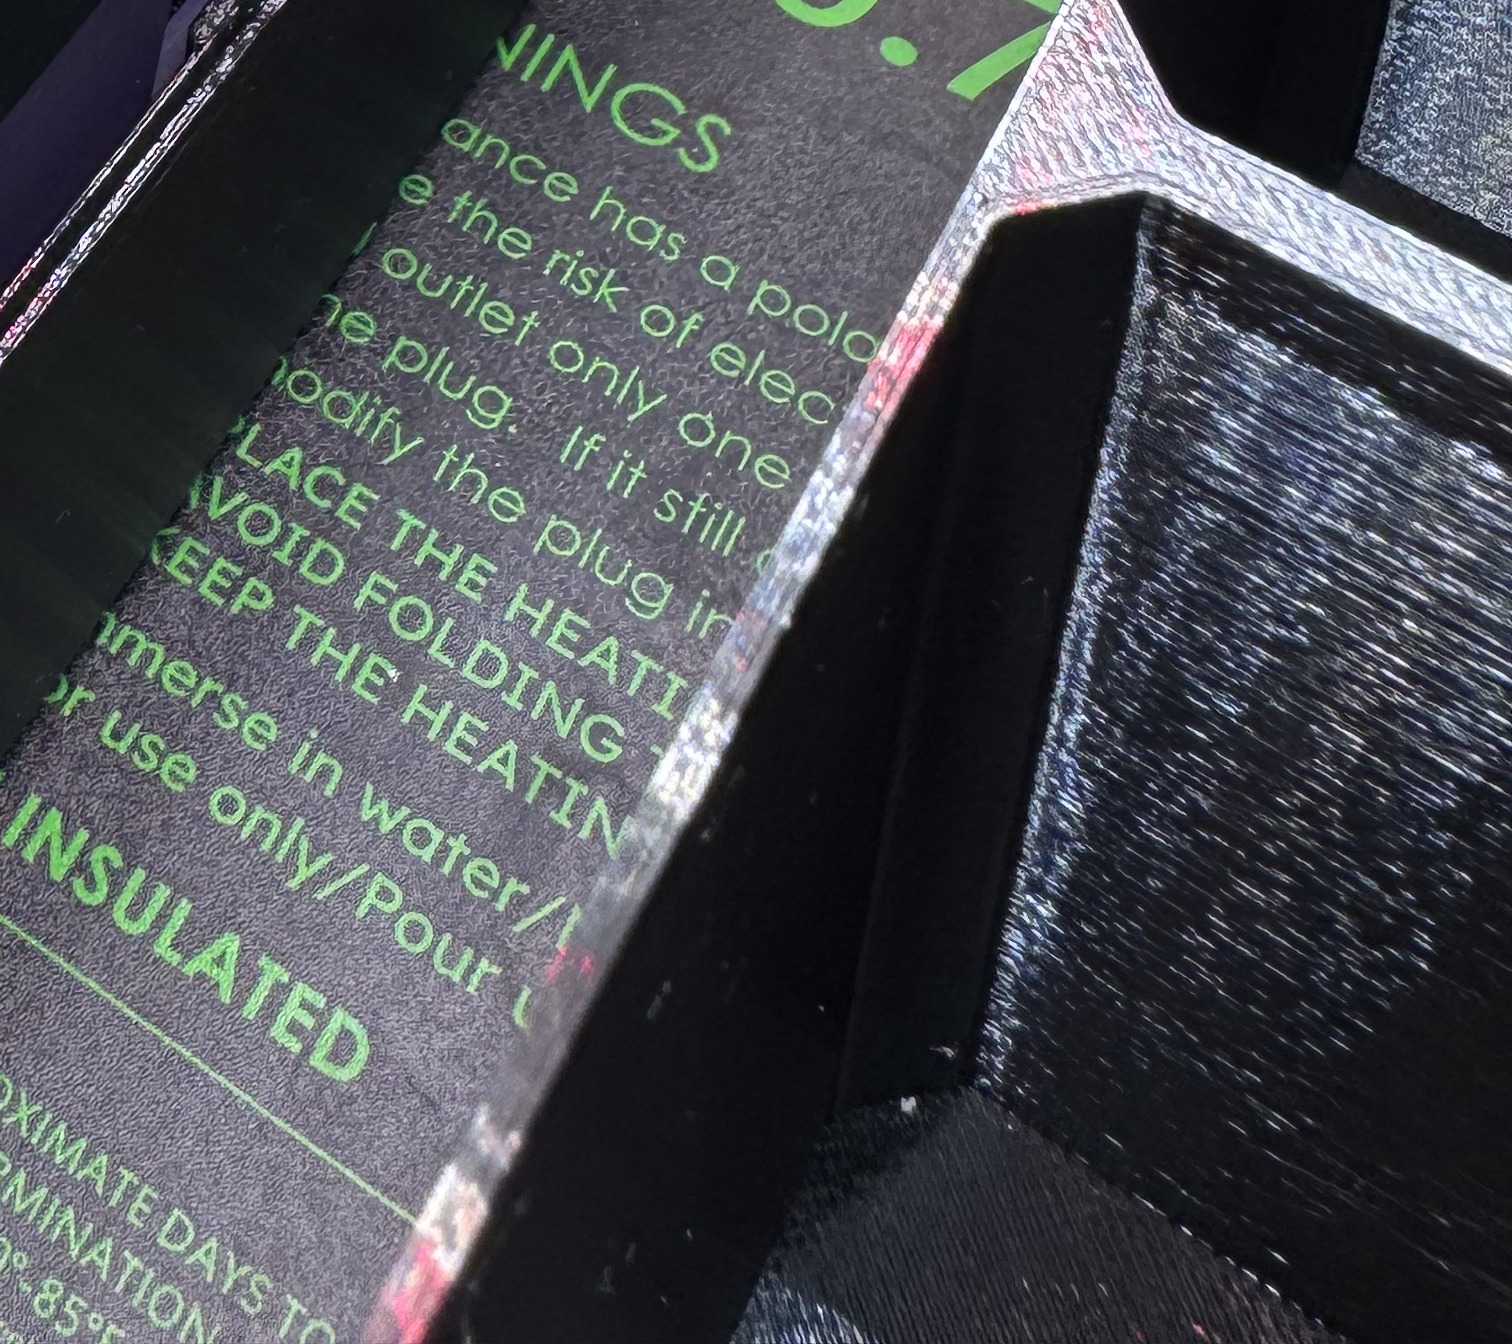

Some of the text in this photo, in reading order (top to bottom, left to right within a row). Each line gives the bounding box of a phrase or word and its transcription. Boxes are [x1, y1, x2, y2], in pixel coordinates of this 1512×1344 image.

[441, 118, 579, 203] ance
[590, 187, 688, 261] has
[700, 255, 739, 291] a
[446, 191, 533, 259] the
[543, 249, 630, 313] risk
[640, 304, 705, 349] of
[710, 342, 836, 425] elec
[382, 247, 792, 490] outlet only one
[382, 335, 518, 434] plug.
[561, 425, 606, 470] If
[607, 449, 647, 497] it
[654, 489, 746, 557] still
[227, 415, 690, 722] LACE THE HEATI
[273, 356, 424, 464] odify
[433, 444, 526, 523] the
[533, 514, 675, 621] plug
[100, 710, 197, 792] use
[287, 605, 396, 705] THE
[400, 683, 635, 860] HEATIN
[288, 728, 344, 797] in
[353, 570, 624, 763] FOLDING
[1, 792, 371, 1082] INSULATED
[157, 1207, 275, 1314] DAYS
